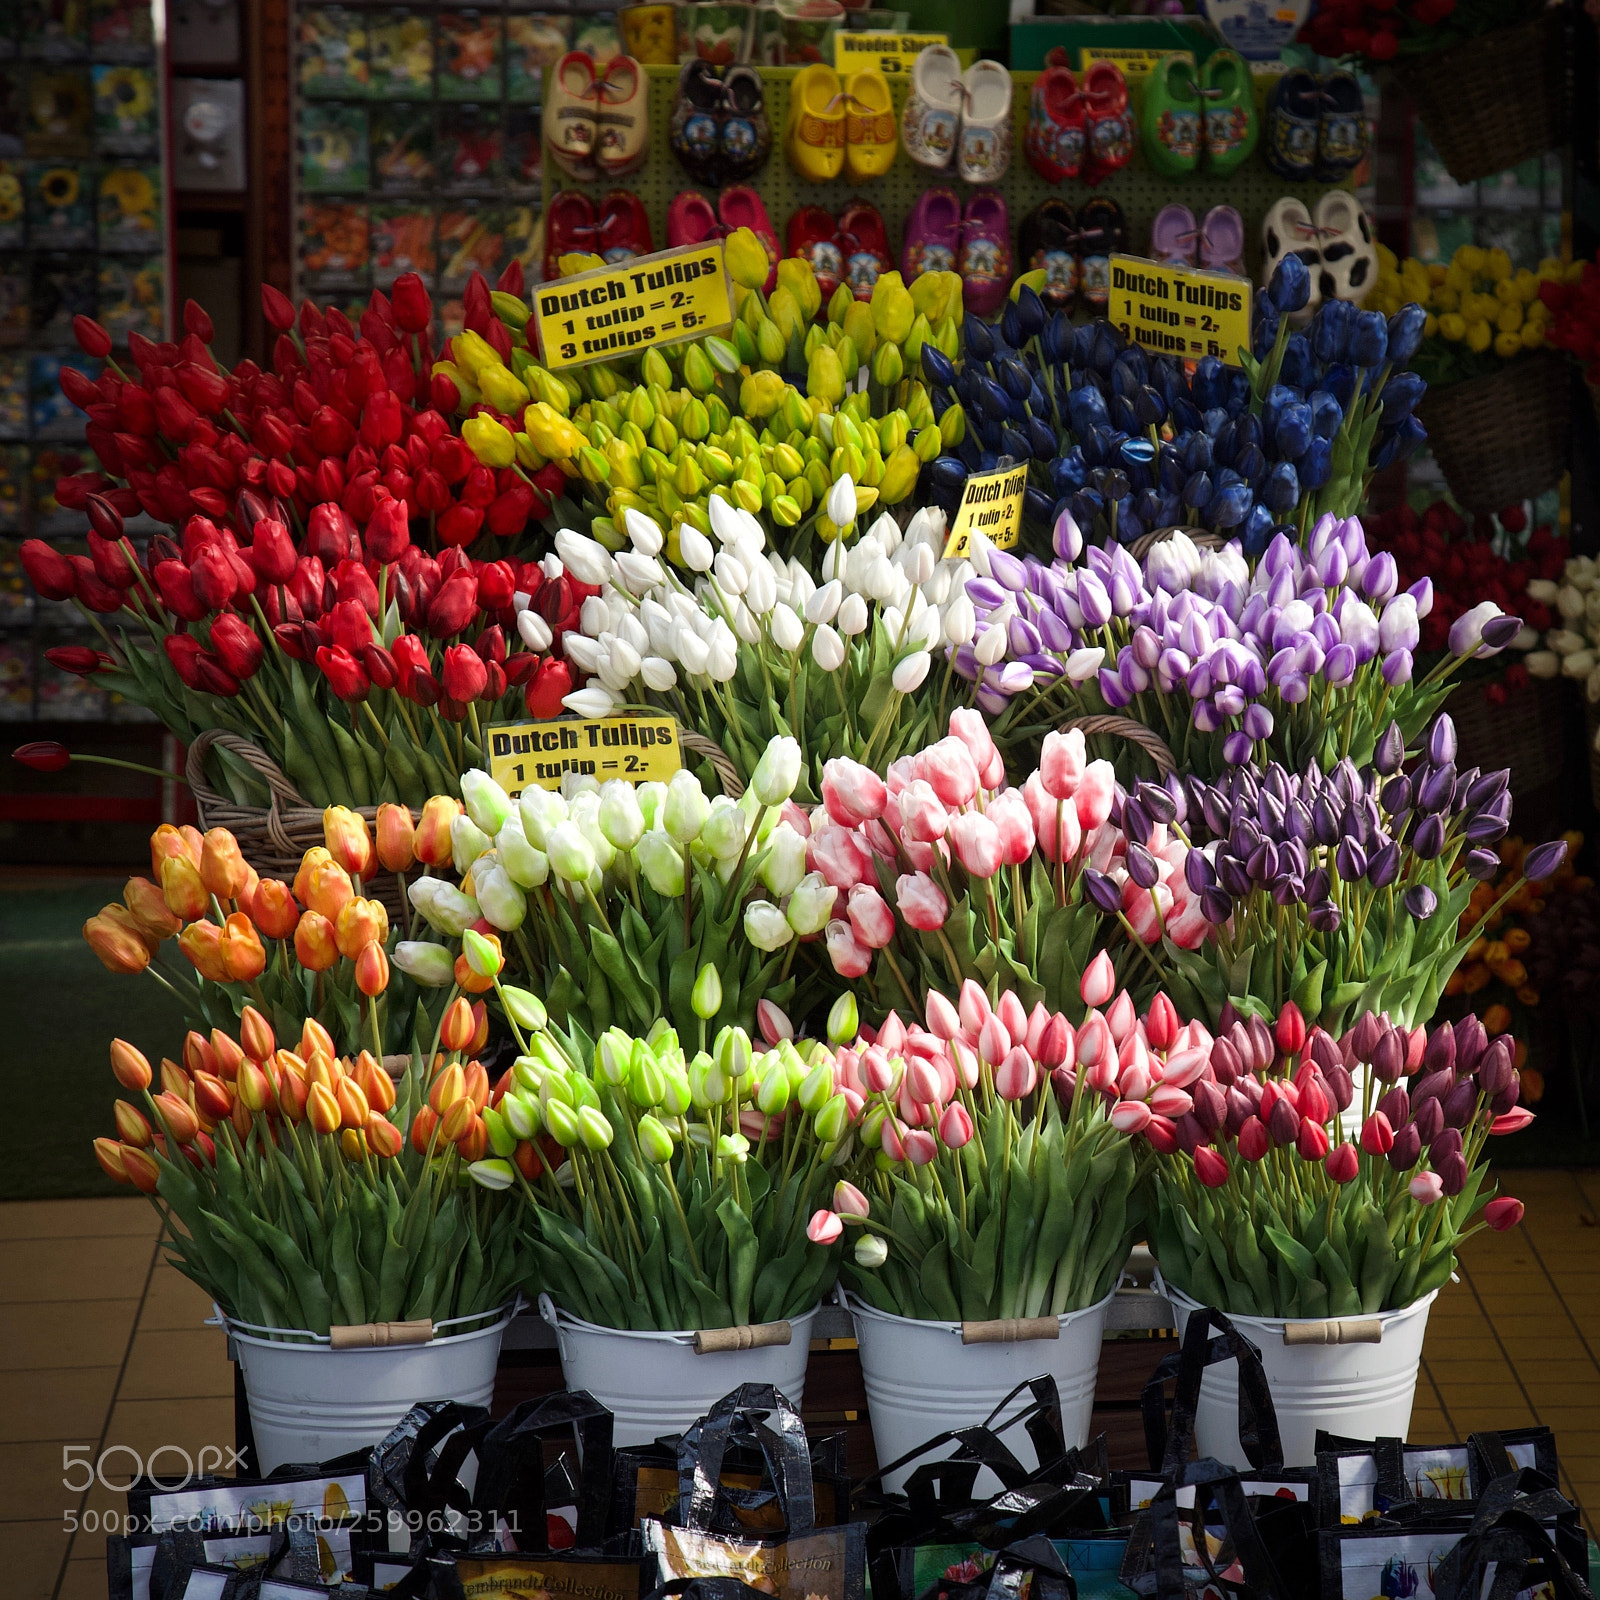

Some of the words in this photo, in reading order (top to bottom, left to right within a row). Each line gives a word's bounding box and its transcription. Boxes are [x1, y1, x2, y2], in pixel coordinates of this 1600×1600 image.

[541, 280, 626, 317] Dutch
[630, 257, 717, 294] Tulips
[1113, 267, 1169, 299] Dutch
[1173, 280, 1242, 311] Tulips
[562, 320, 575, 335] 1
[586, 305, 645, 331] tulip
[1123, 300, 1132, 316] 1
[1139, 304, 1180, 327] tulip
[561, 343, 577, 359] 3
[582, 325, 656, 354] tulips
[1119, 323, 1131, 341] 3
[1135, 326, 1186, 352] tulips
[965, 480, 1001, 504] Dutch
[1002, 475, 1025, 499] Tulips
[969, 513, 974, 528] 1
[978, 509, 1001, 527] tulip
[957, 536, 968, 551] 3
[492, 727, 578, 756] Dutch
[584, 723, 673, 750] Tulips
[513, 764, 525, 781] 1
[535, 758, 596, 779] tulip
[466, 1574, 540, 1597] embrandt
